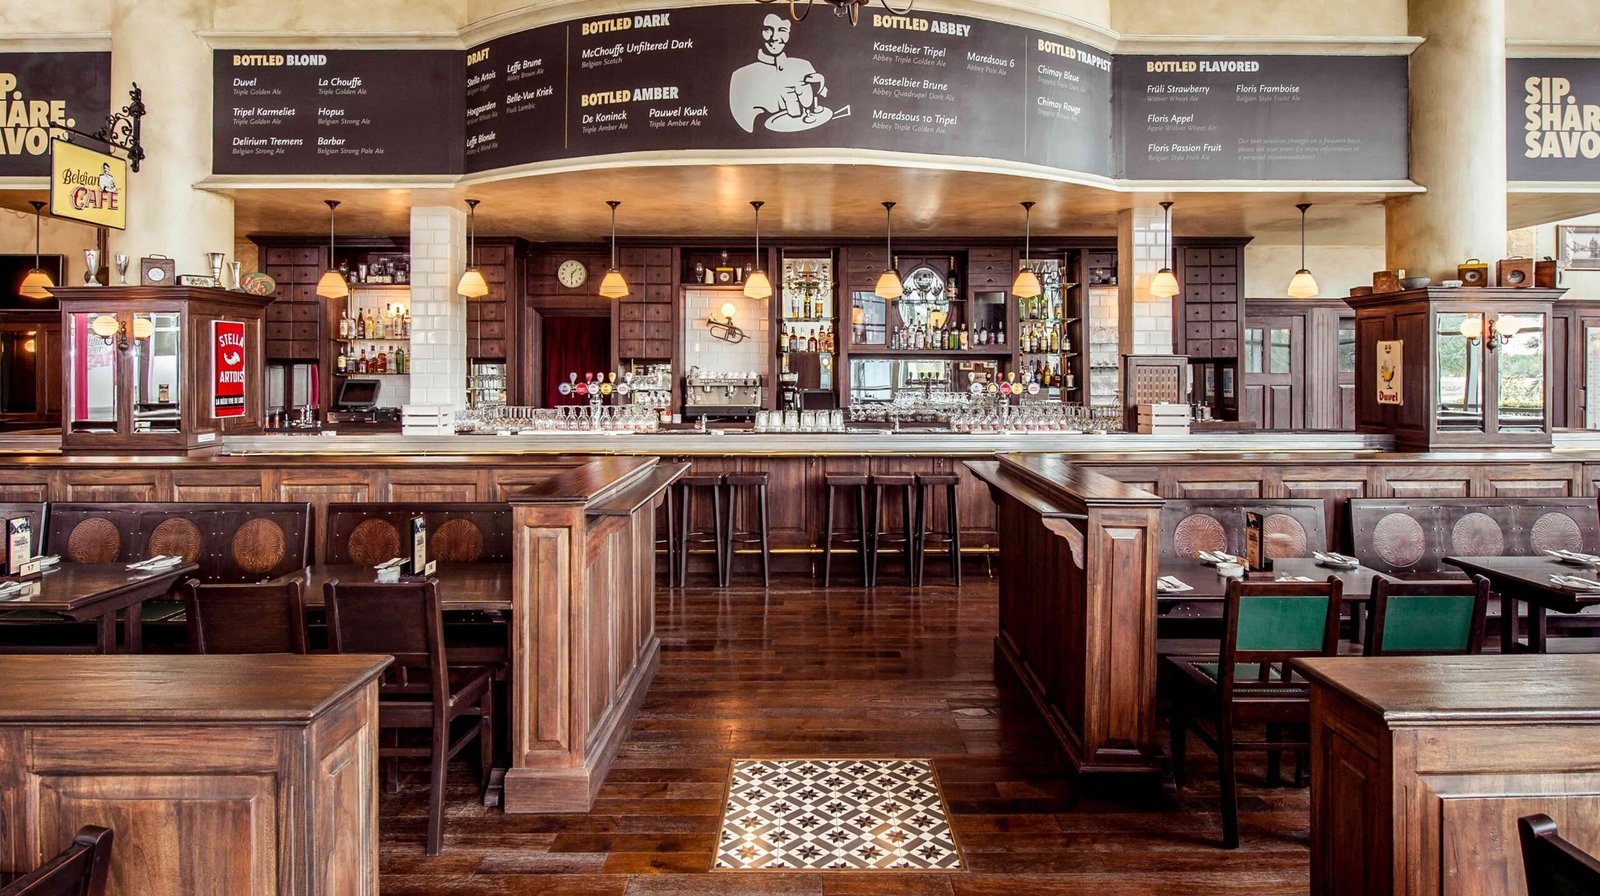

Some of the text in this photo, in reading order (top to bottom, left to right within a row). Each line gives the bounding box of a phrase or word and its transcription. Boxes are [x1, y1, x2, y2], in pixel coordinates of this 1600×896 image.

[582, 13, 670, 35] BOTTLED DARK
[873, 14, 971, 37] BOTTLED ABBEY
[582, 38, 693, 58] McChouffe Unfiltered Dark
[873, 42, 946, 59] Kasteelbier Tripel
[233, 55, 327, 66] BOTTLED BLOND
[467, 47, 490, 66] DRAFT
[873, 54, 893, 62] Abbey
[895, 56, 911, 64] Triple
[913, 58, 935, 66] Golden
[967, 51, 1015, 68] Maredsous 6
[1038, 39, 1111, 72] BOTTLED TRAPPIST
[507, 59, 542, 74] Leffe Brune
[582, 57, 622, 69] Belgian Scotch
[967, 64, 984, 72] Abbey
[1147, 61, 1259, 72] BOTTLED FLAVORED
[481, 70, 496, 82] Artois
[1038, 65, 1062, 80] Chimay
[233, 78, 256, 86] Duvel
[318, 77, 361, 88] La Chouffe
[873, 76, 948, 91] Kasteelbier Brune
[507, 86, 553, 104] Belle-Vue Kriek
[872, 88, 892, 97] Abbey
[894, 90, 927, 99] Quadrupel
[1147, 85, 1210, 95] Früli Strawberry
[1236, 85, 1300, 93] Floris Framboise
[1525, 77, 1575, 104] SIP.
[581, 87, 679, 107] BOTTLED AMBER
[649, 106, 708, 117] Pauwel Kwak
[1038, 97, 1062, 111] Chimay
[1063, 102, 1081, 115] Rouge
[233, 108, 295, 117] Tripel Karmeliet
[318, 108, 344, 117] Hopus
[583, 110, 627, 123] De Koninck
[873, 110, 920, 122] Maredsous
[935, 114, 958, 126] Tripel
[649, 120, 665, 129] Triple
[667, 119, 688, 127] Amber
[1148, 114, 1194, 124] Floris Appel
[582, 126, 596, 134] Triple
[872, 122, 892, 130] Abbey
[894, 123, 911, 132] Triple
[913, 125, 935, 133] Golden
[233, 137, 267, 145] Delirium
[318, 137, 345, 145] Barbar
[1148, 144, 1222, 152] Floris Passion Fruit
[63, 168, 100, 186] Belgian
[219, 333, 244, 348] STELLA
[220, 371, 244, 383] ARTOIS
[1379, 390, 1398, 401] Duvel
